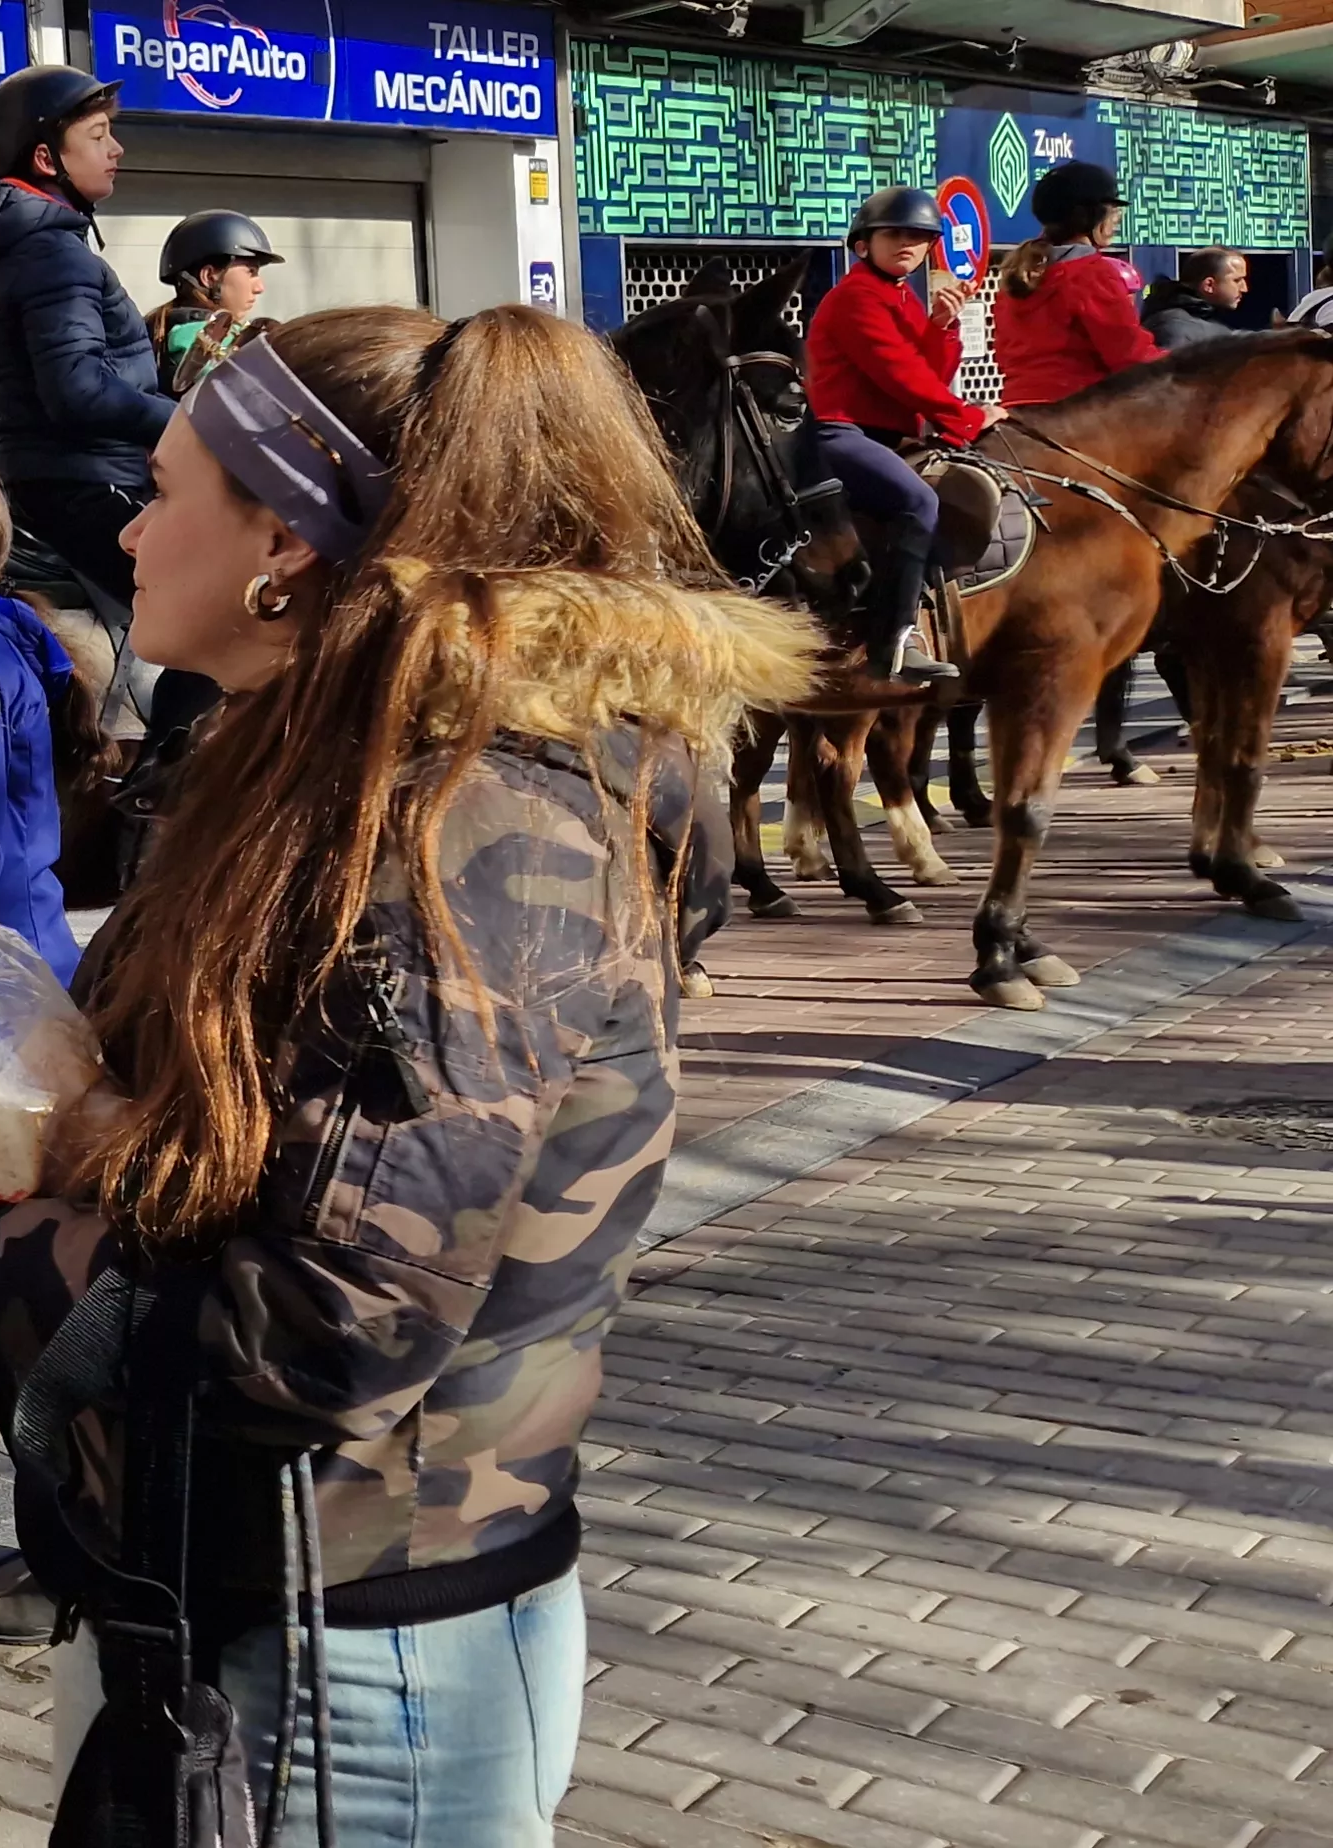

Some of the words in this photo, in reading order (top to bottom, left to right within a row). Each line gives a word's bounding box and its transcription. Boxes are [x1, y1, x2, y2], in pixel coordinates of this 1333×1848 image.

[115, 24, 307, 81] ReparAuto
[428, 22, 540, 69] TALLER
[374, 70, 541, 120] MECÁNICO
[1034, 128, 1074, 164] Zynk
